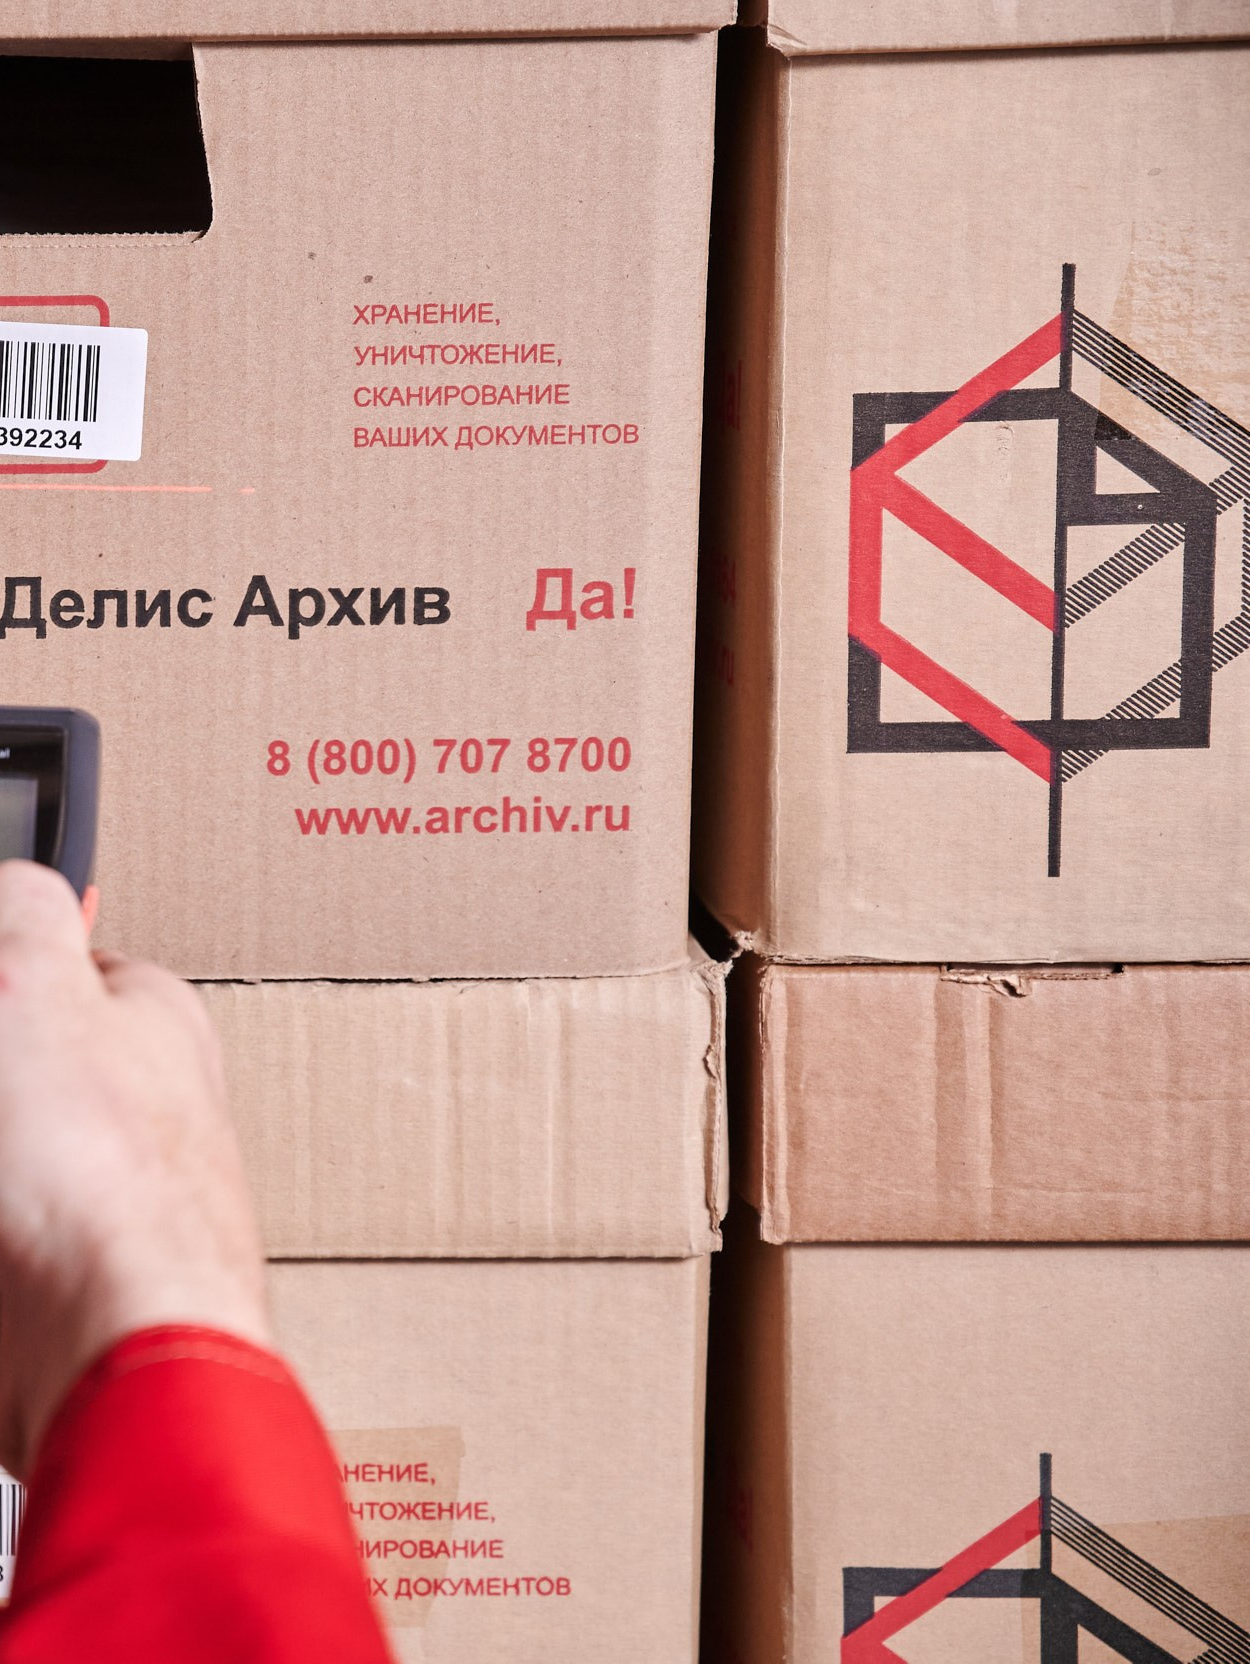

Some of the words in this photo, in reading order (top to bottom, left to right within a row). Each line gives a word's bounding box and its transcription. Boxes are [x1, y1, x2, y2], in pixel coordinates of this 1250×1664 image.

[353, 303, 500, 326] ХРАНЕНИЕ,
[354, 343, 562, 367] УНИЧТОЖЕНИЕ,
[353, 384, 570, 407] СКАНИРОВАНИЕ
[353, 427, 448, 448] ВАШИХ
[455, 424, 639, 450] ДОКУМЕНТОВ
[233, 575, 452, 640] Архив
[526, 567, 637, 631] Да!
[266, 740, 291, 776] 8
[308, 738, 417, 784] (800)
[434, 738, 511, 774] 707
[527, 736, 632, 772] 8700
[295, 797, 631, 836] www.archiv.ru
[394, 1576, 572, 1600] ДОКУМЕНТОВ
